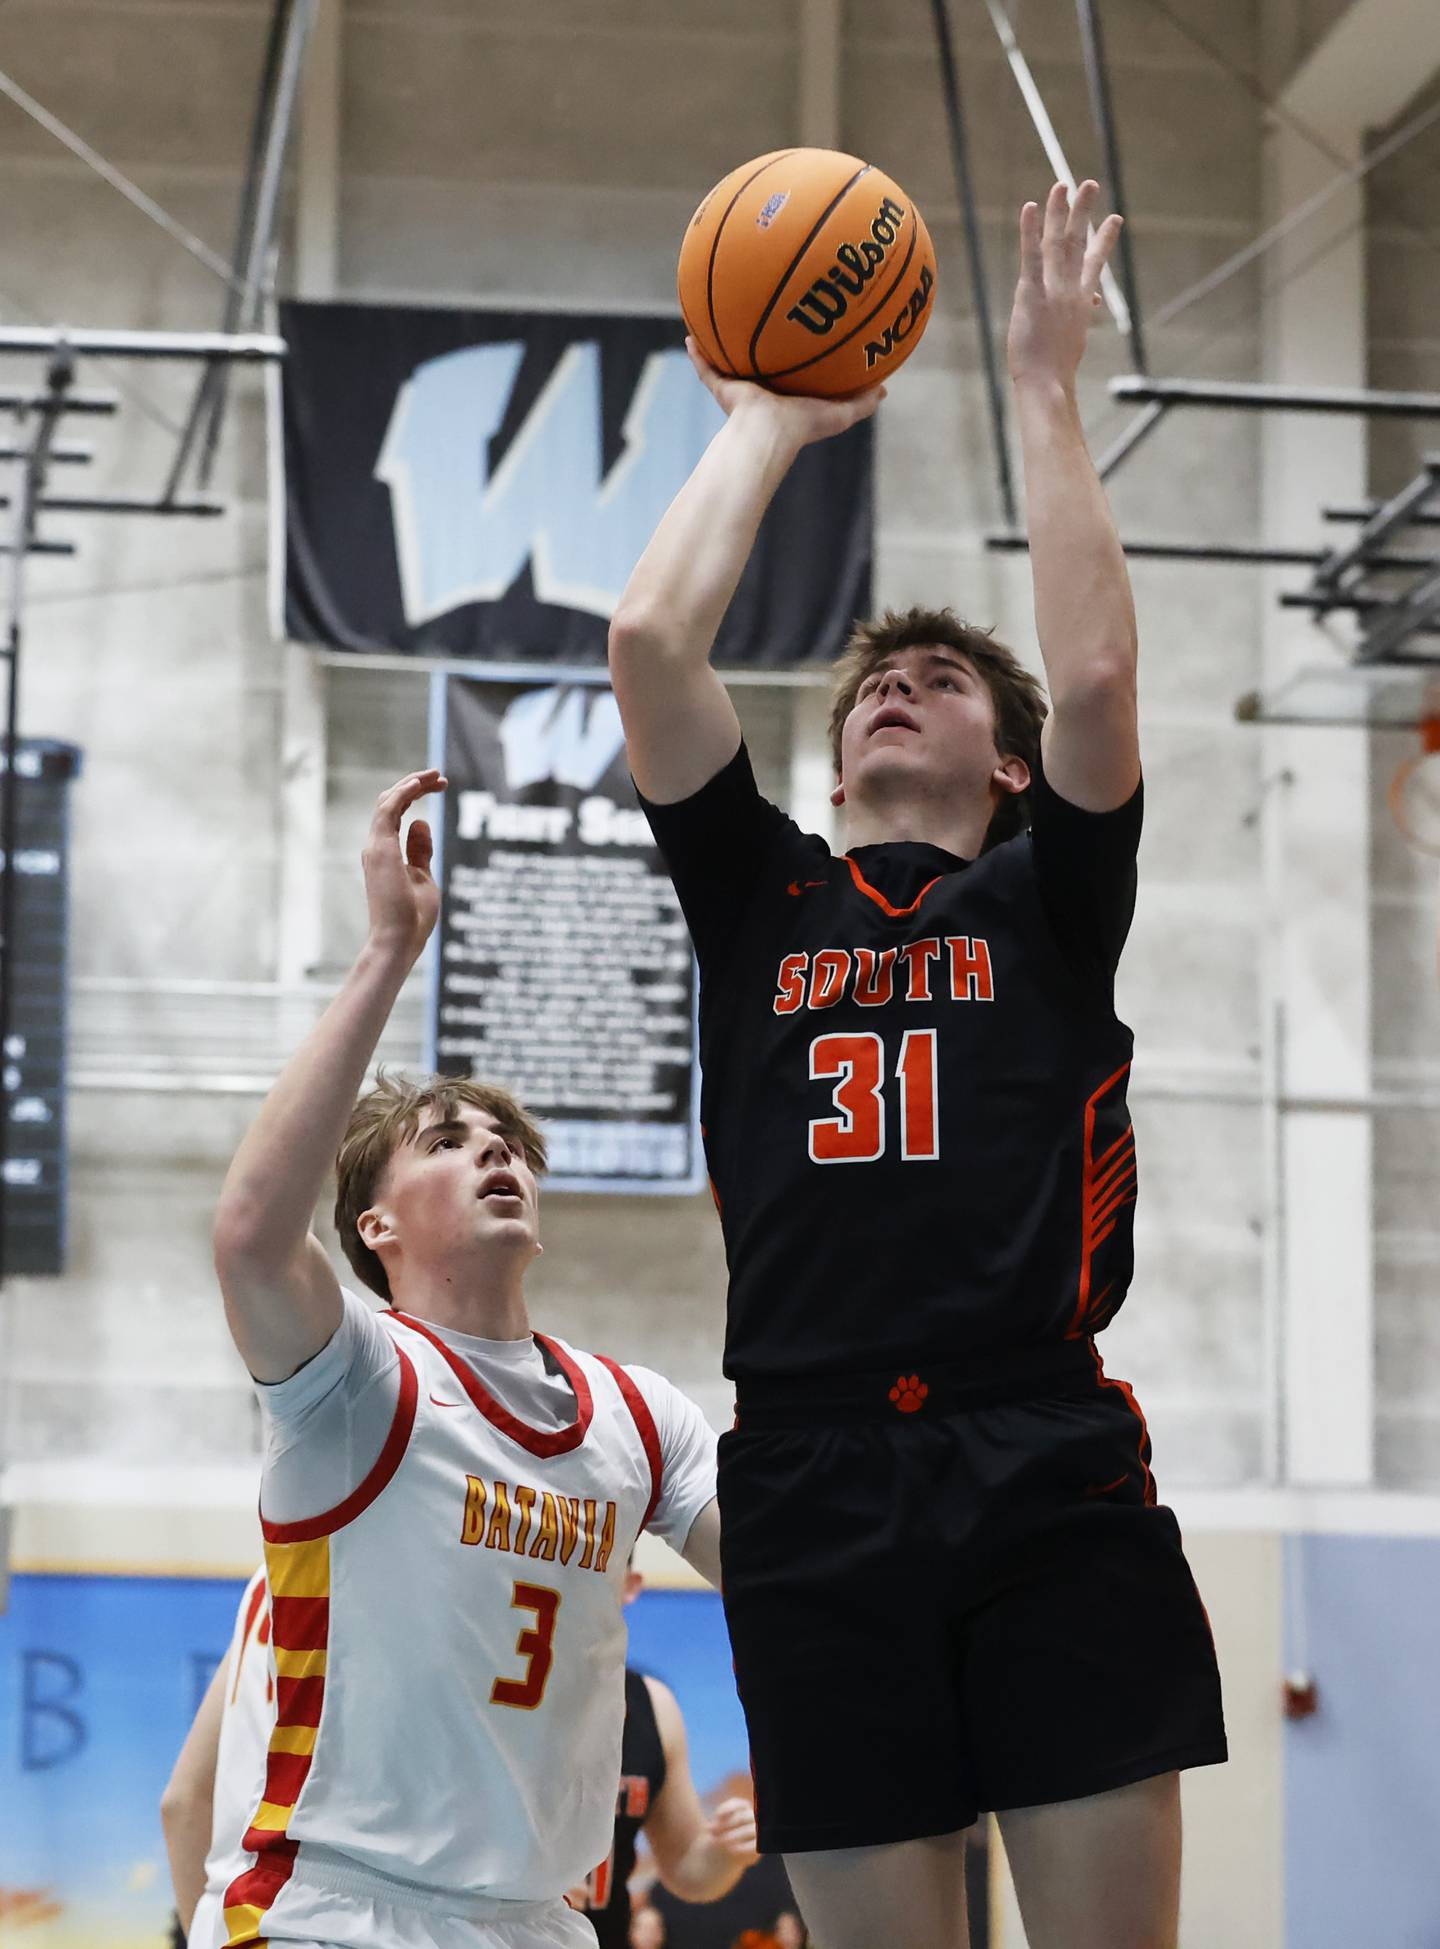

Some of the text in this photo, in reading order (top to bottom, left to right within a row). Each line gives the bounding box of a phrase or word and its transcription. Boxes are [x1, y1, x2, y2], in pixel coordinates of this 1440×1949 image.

[786, 197, 905, 335] Wilson
[864, 265, 933, 369] NCAA
[373, 338, 728, 628] W
[773, 936, 994, 1015] SOUTH
[808, 1028, 939, 1165] 31
[460, 1474, 616, 1572] BATAVIA
[489, 1580, 561, 1711] 3
